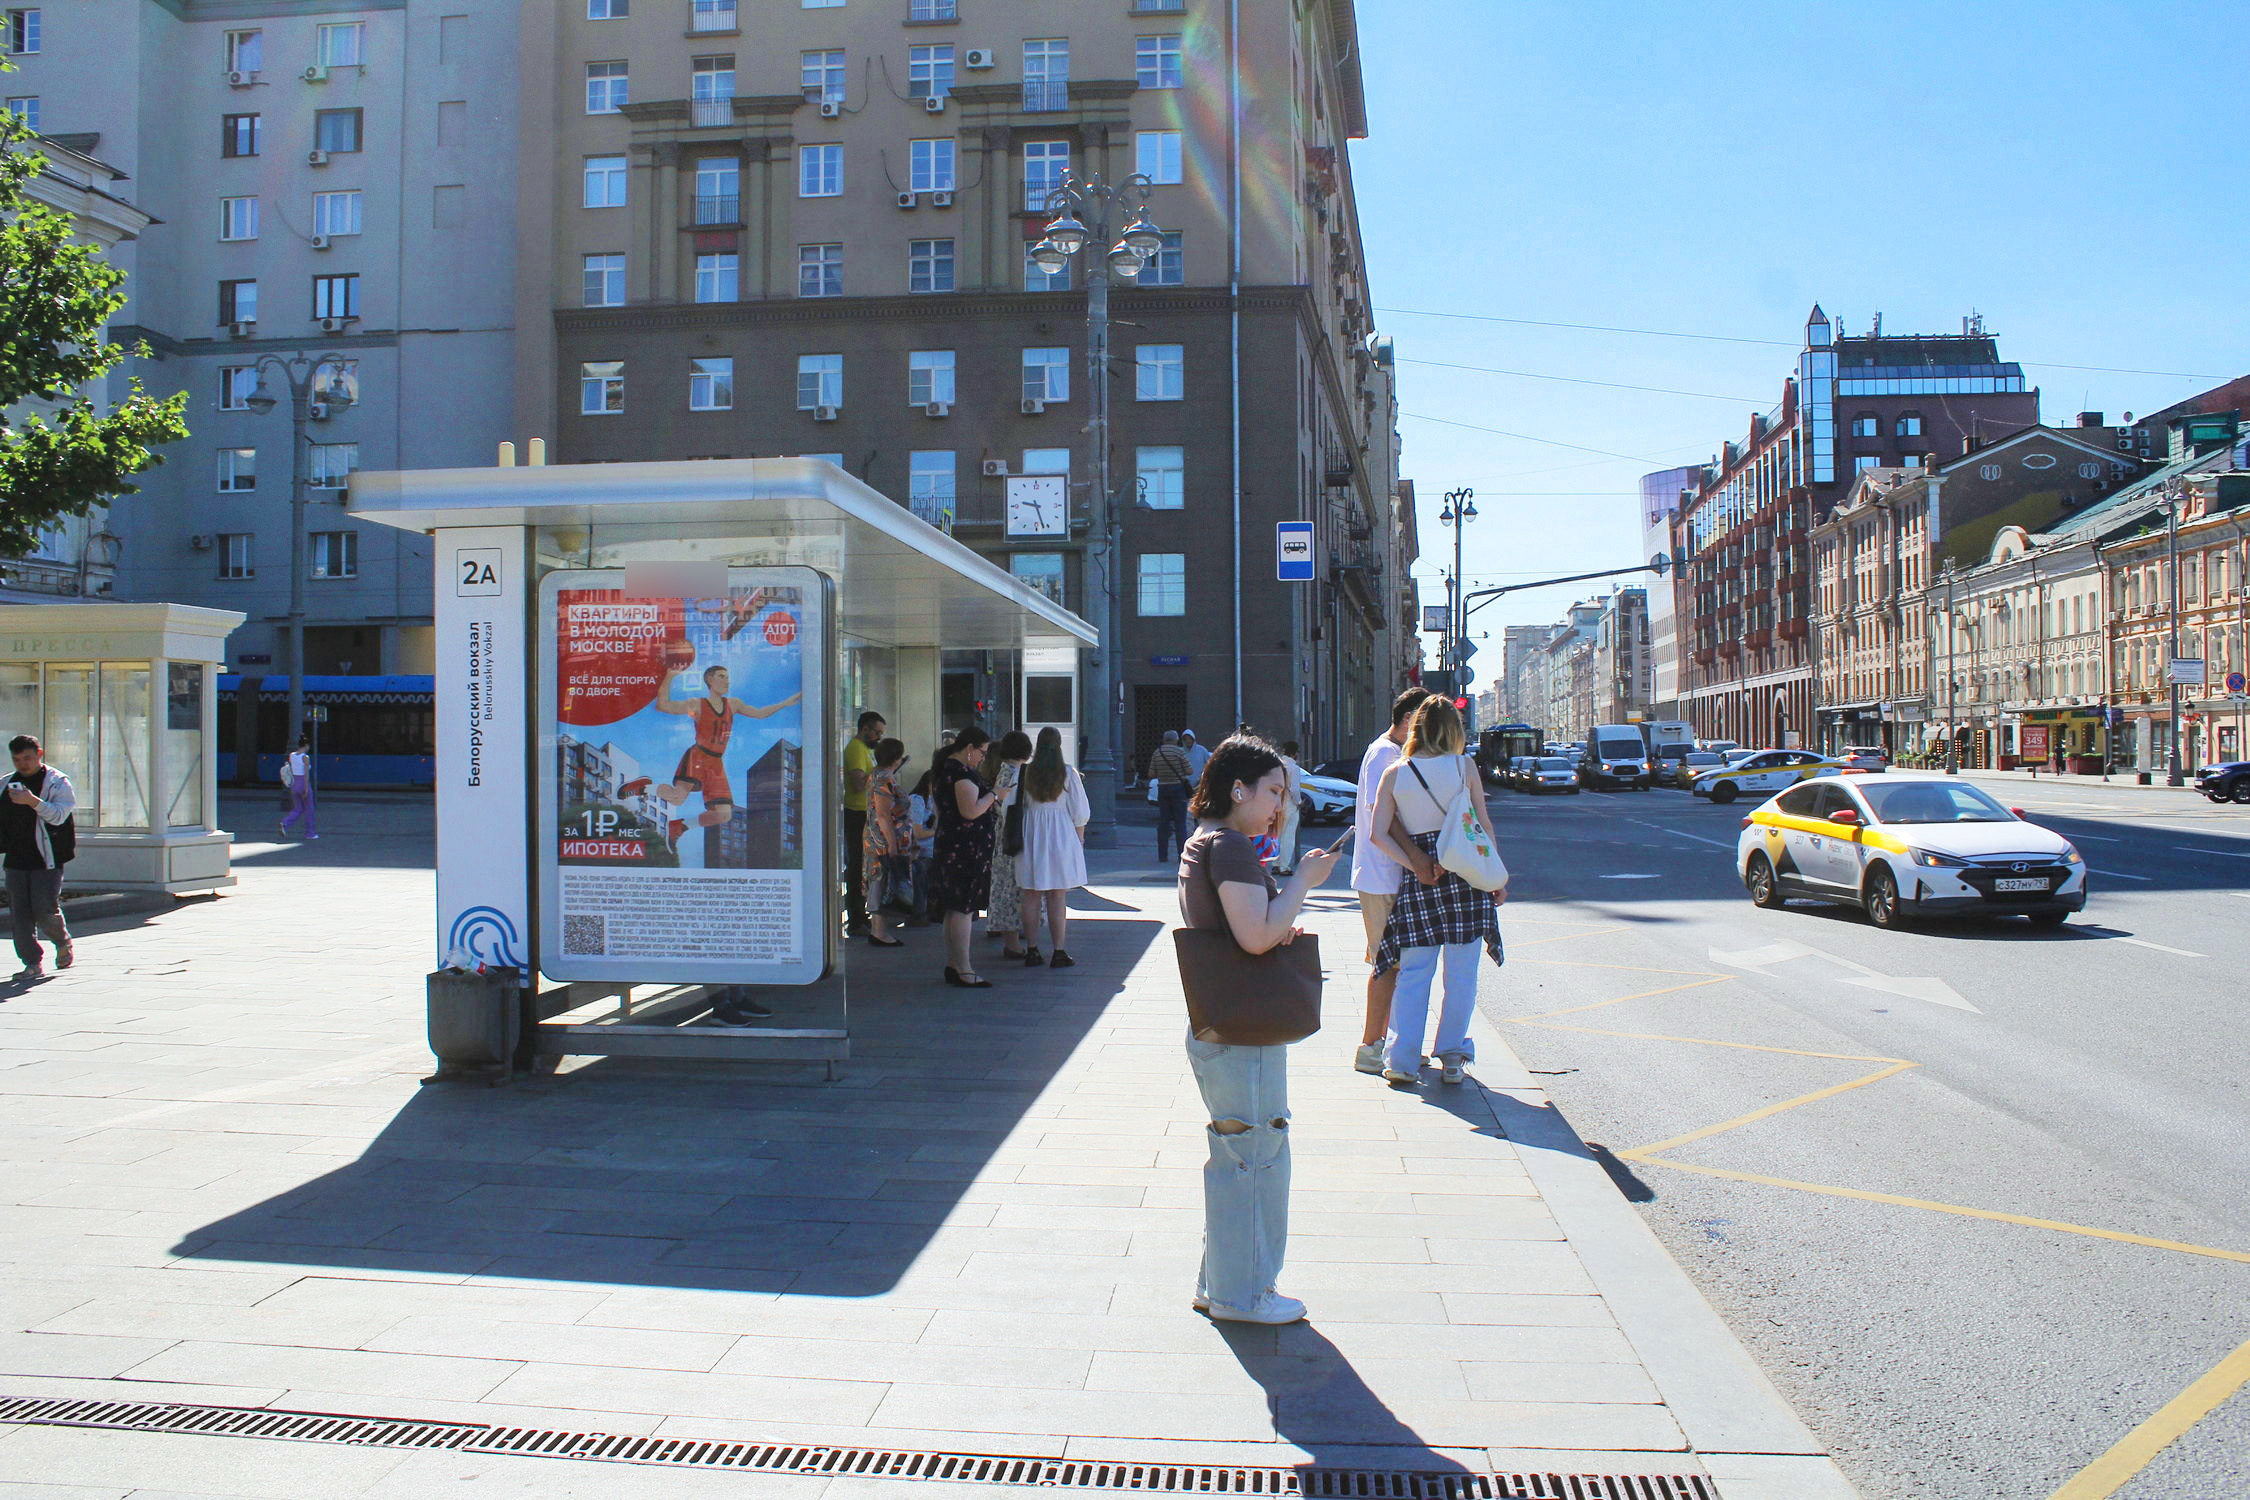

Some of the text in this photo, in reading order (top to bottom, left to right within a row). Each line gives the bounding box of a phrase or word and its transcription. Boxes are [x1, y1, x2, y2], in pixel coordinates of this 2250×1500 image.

[570, 607, 656, 620] КВАРТИРЫ
[570, 622, 666, 639] В МОЛОДОЙ
[12, 639, 113, 652] ПРЕССА
[569, 640, 634, 653] МОСКВЕ
[484, 621, 494, 720] Belorusskiy Vokzal
[569, 674, 589, 684] ВСЁ
[591, 676, 612, 685] ДЛЯ
[569, 687, 621, 697] ВО ДВОРЕ
[467, 622, 483, 788] Белорусский вокзал
[2025, 736, 2043, 745] 349
[564, 828, 579, 837] ЗА
[563, 841, 644, 857] ИПОТЕКА
